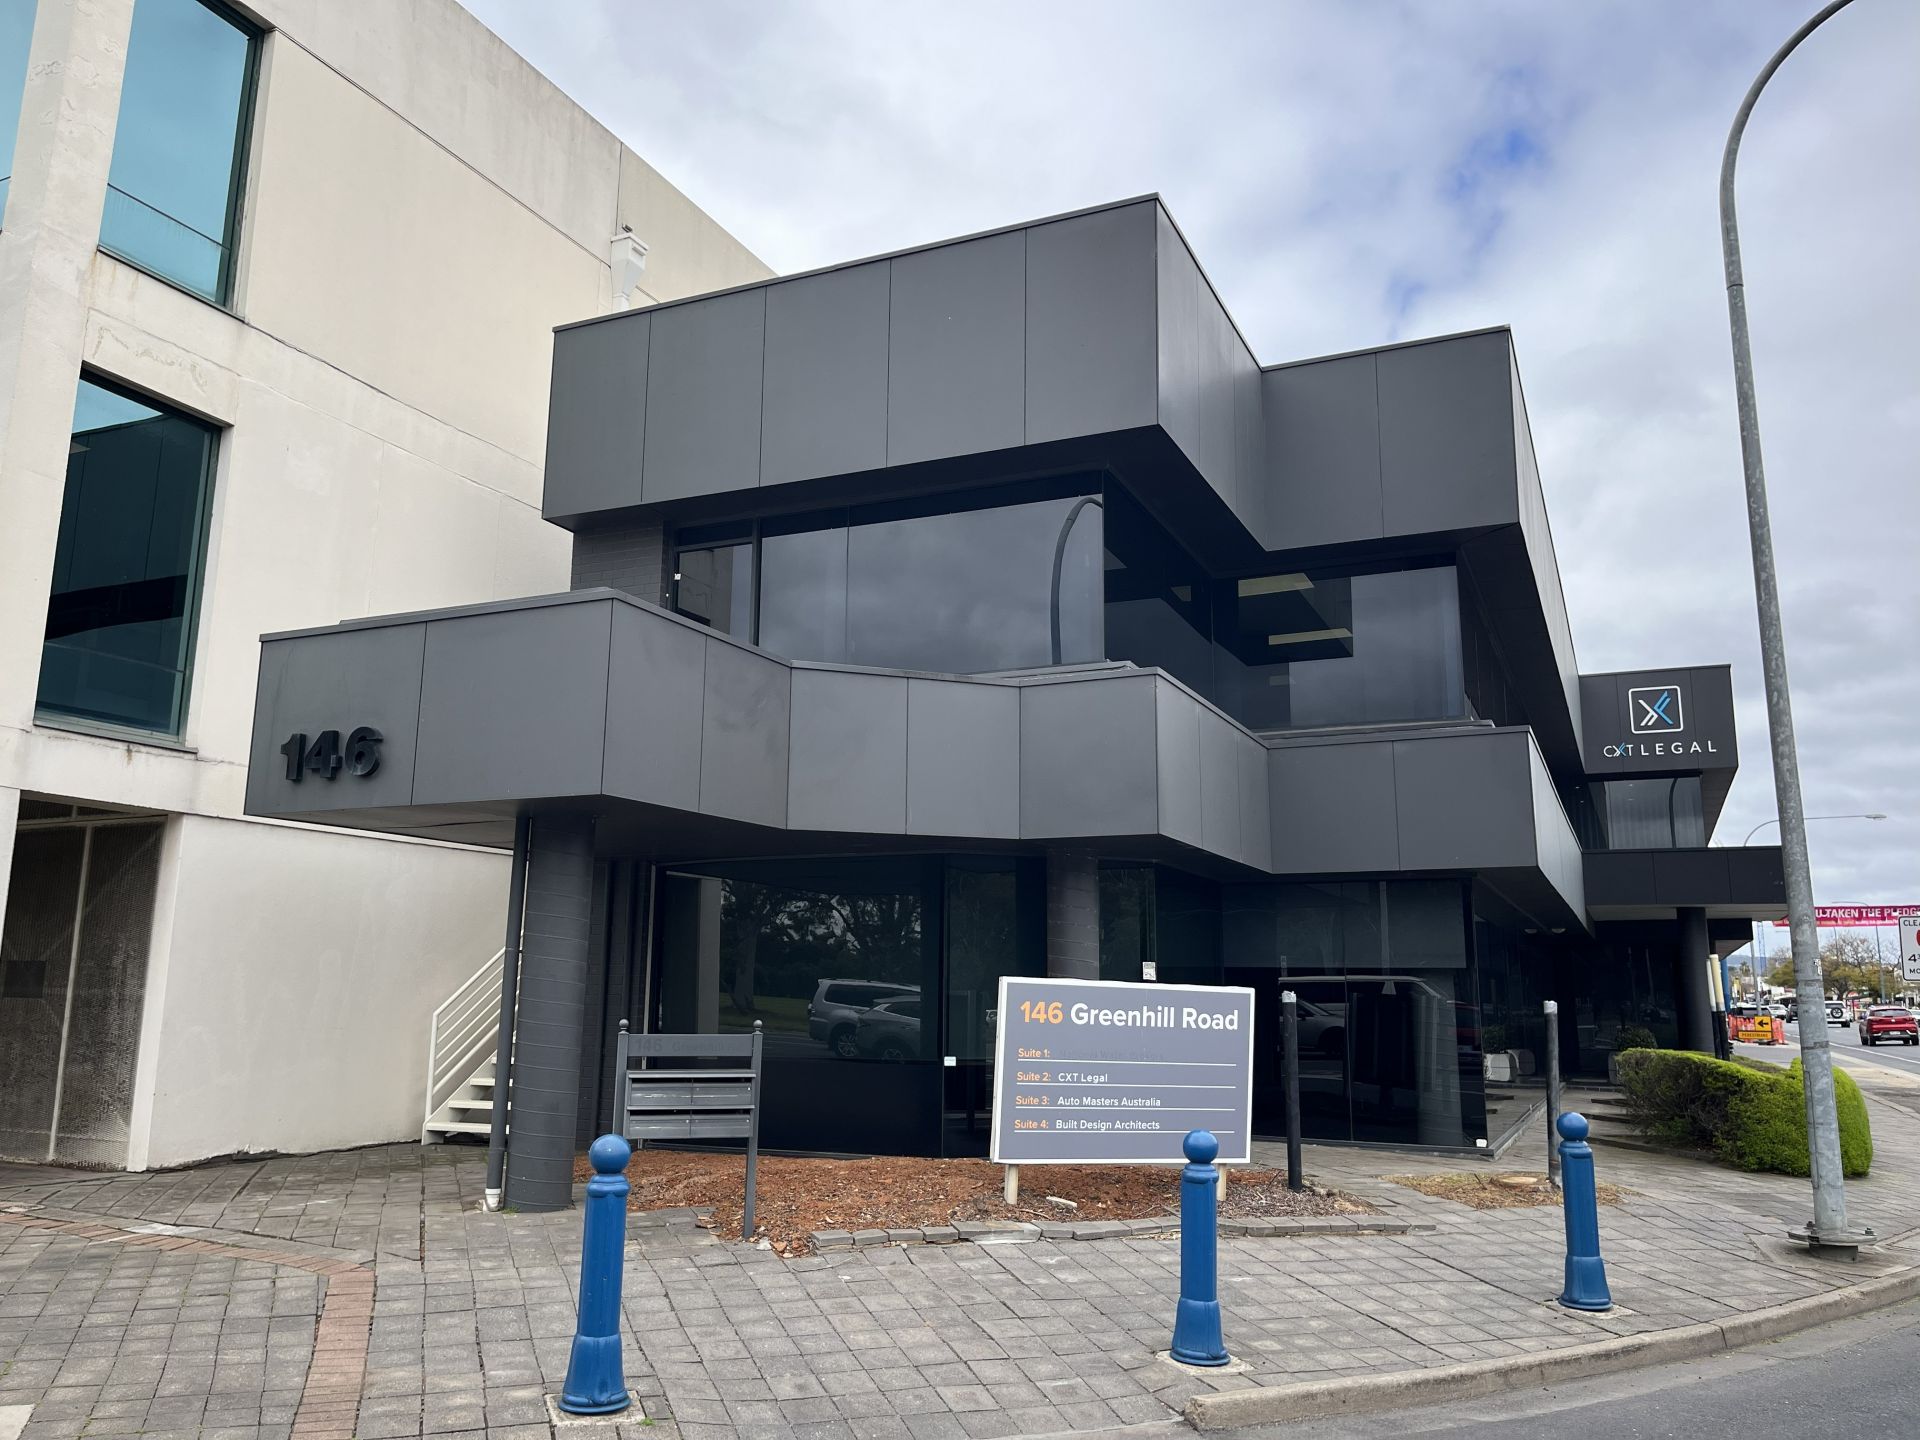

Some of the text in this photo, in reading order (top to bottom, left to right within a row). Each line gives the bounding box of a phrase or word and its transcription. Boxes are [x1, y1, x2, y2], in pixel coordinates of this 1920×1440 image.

[280, 726, 384, 782] 146
[1640, 740, 1717, 756] LEGAL
[1019, 1000, 1239, 1030] 146 Greenhill Road
[1018, 1048, 1041, 1058] Suite
[1043, 1050, 1051, 1058] 1:
[1016, 1072, 1108, 1084] Suite 2: CXT Legal
[1015, 1096, 1161, 1107] Suite 3: Auto Masters Australia
[1014, 1120, 1160, 1132] Suite 4: Built Design Architects
